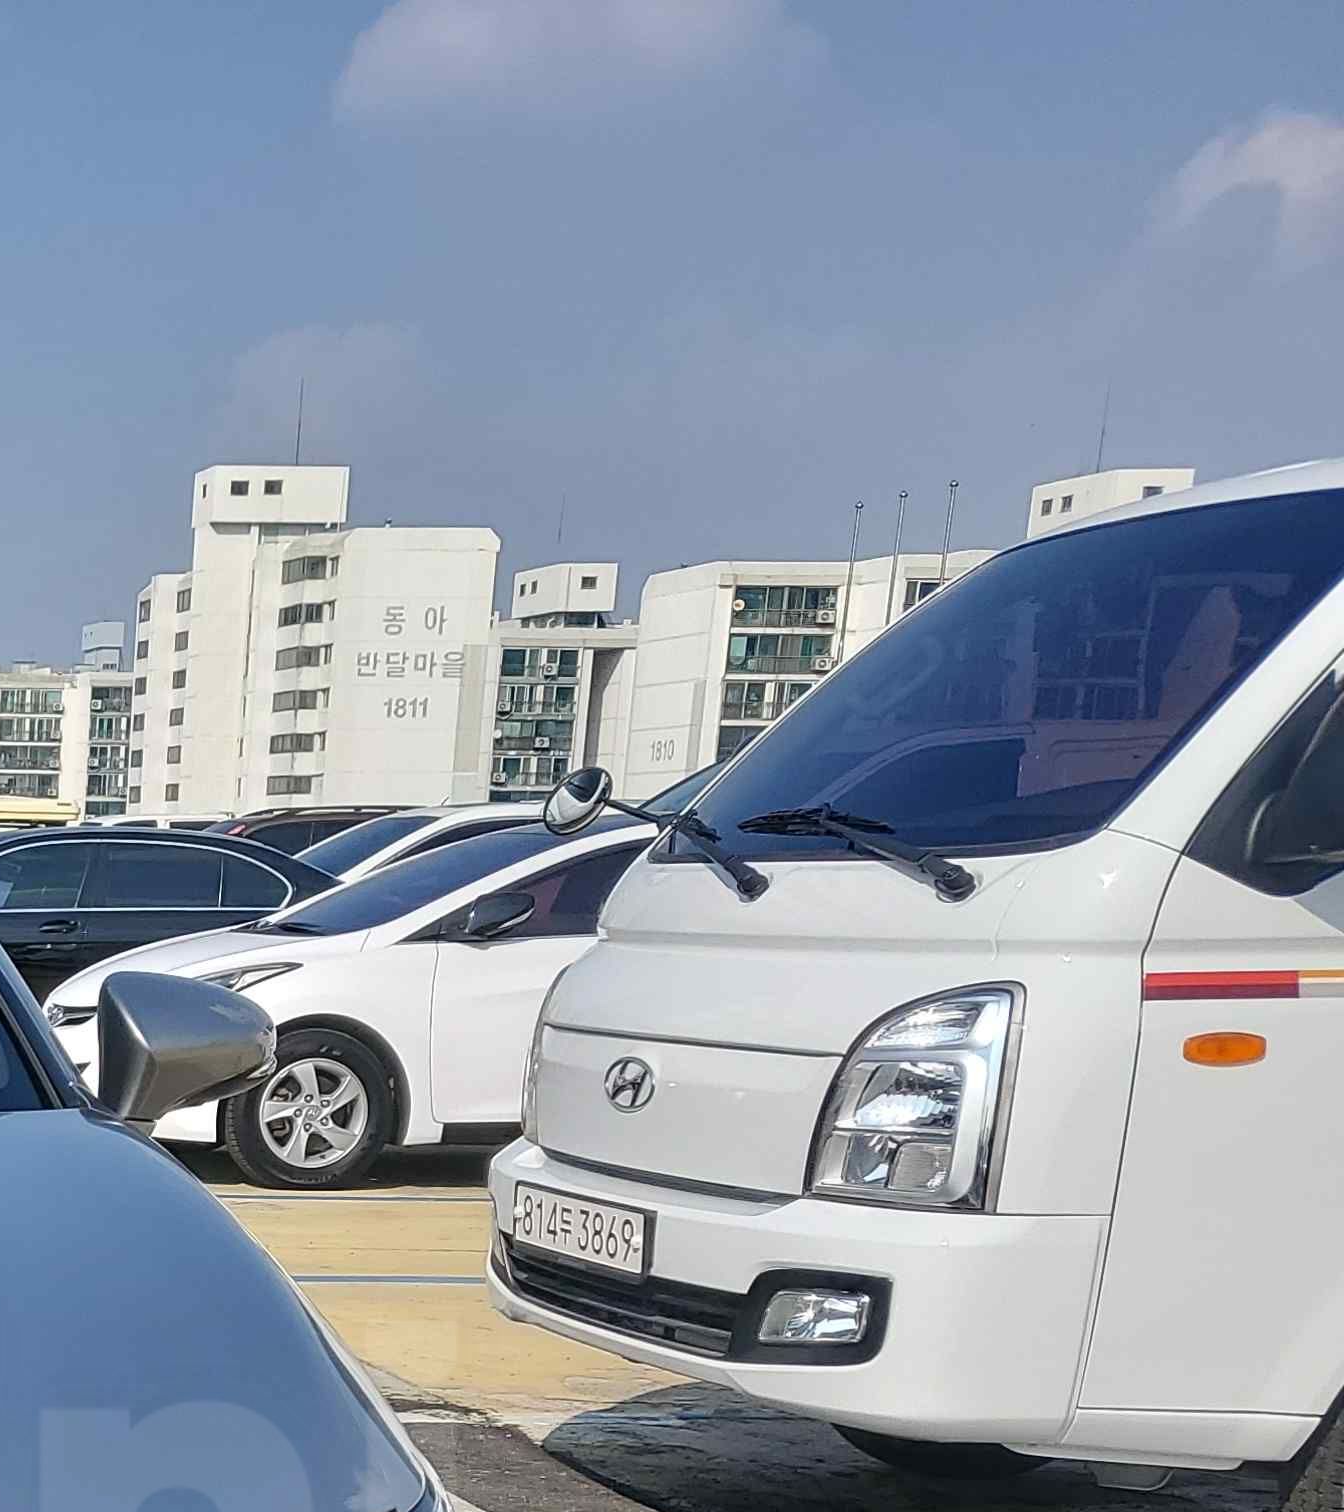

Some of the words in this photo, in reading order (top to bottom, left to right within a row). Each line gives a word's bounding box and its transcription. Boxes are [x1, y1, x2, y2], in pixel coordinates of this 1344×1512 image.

[356, 651, 466, 678] 반달마을
[383, 697, 429, 718] 1811
[650, 739, 675, 761] 1810
[523, 1195, 572, 1246] 814두
[578, 1208, 634, 1262] 3869
